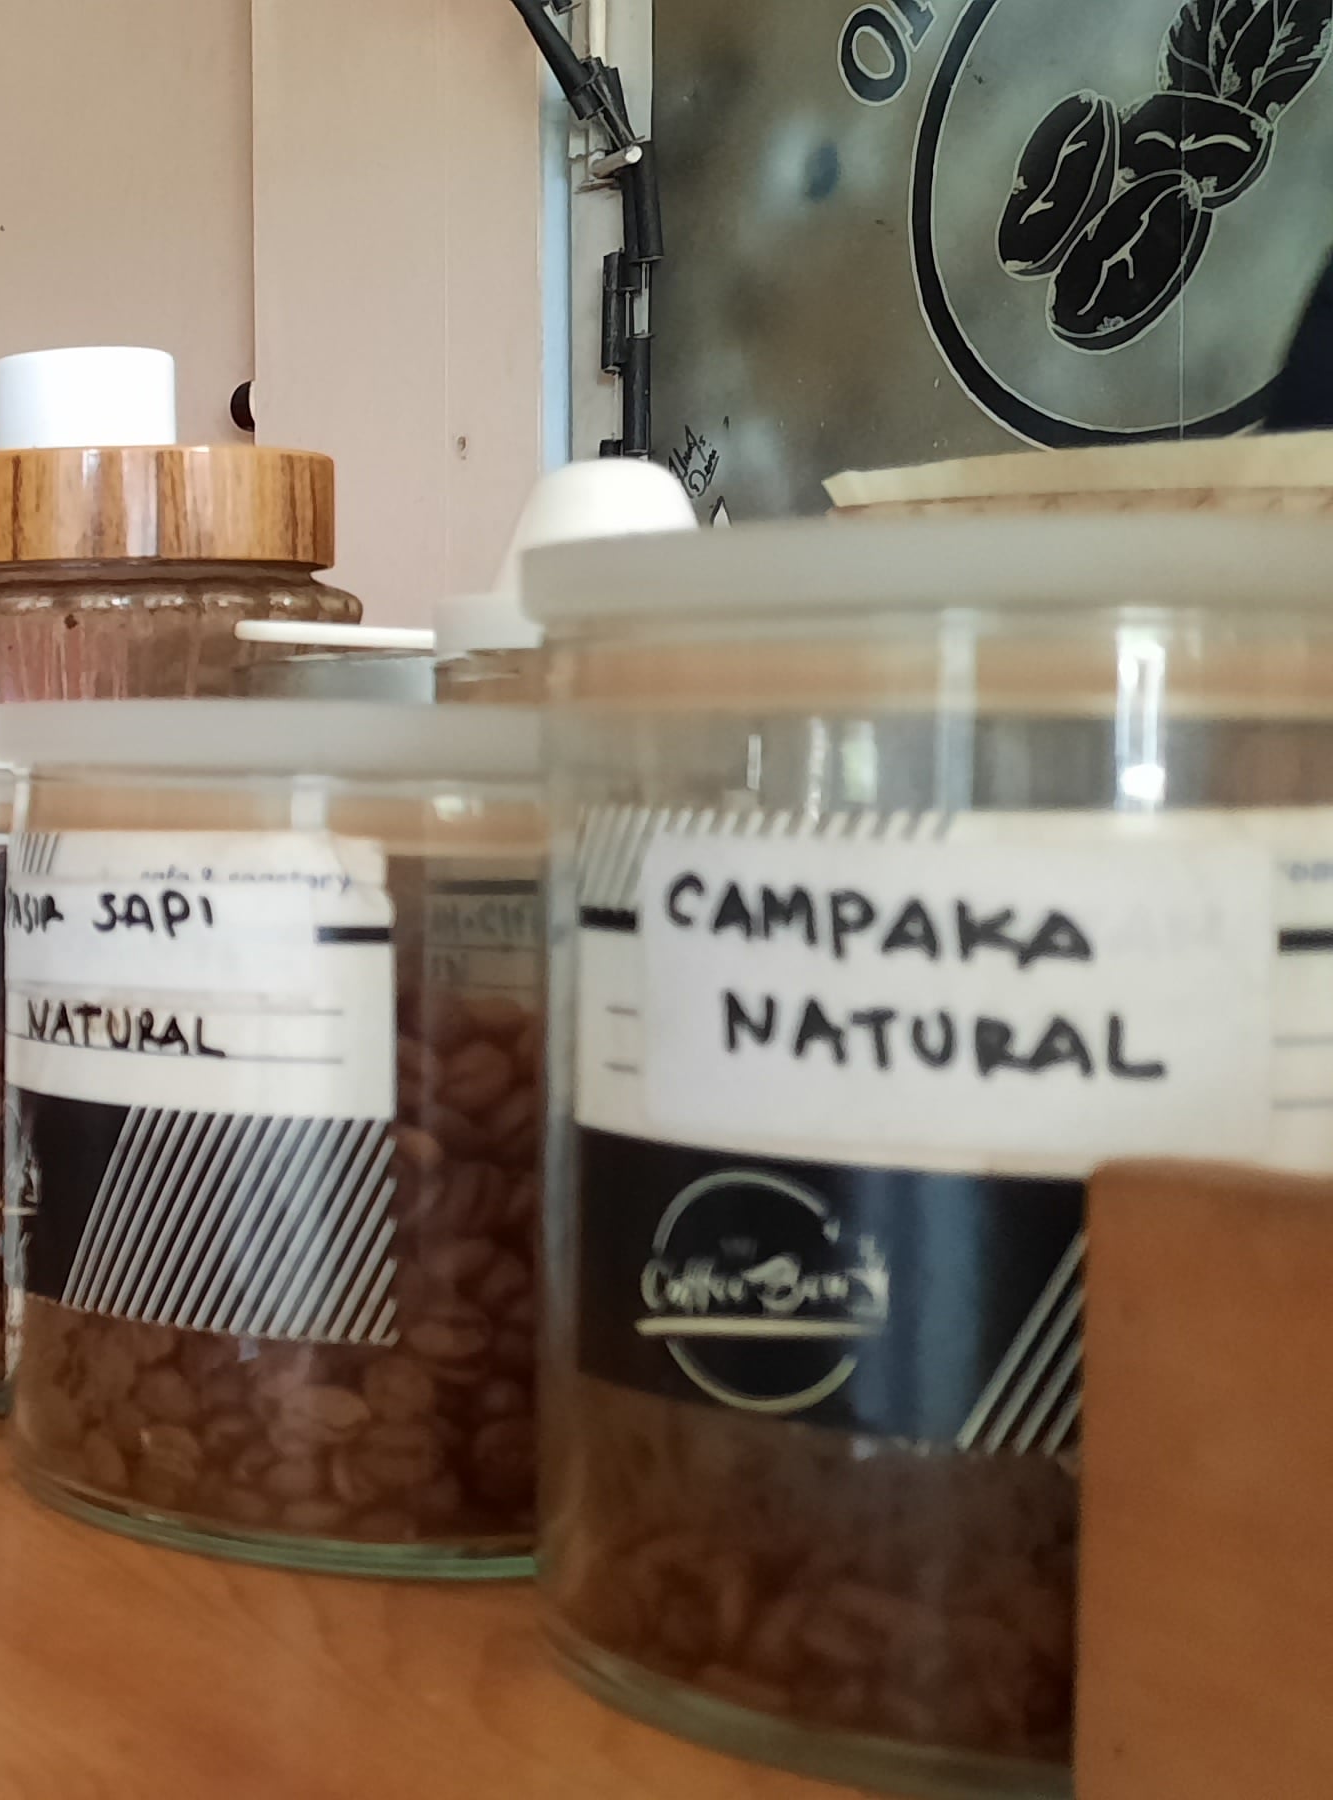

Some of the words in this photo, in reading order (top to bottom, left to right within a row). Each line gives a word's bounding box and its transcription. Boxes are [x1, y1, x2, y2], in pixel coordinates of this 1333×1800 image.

[93, 888, 213, 939] SAPI
[667, 873, 1093, 969] CAMPAKA
[27, 999, 226, 1058] NATURAL
[723, 988, 1166, 1078] NATURAL
